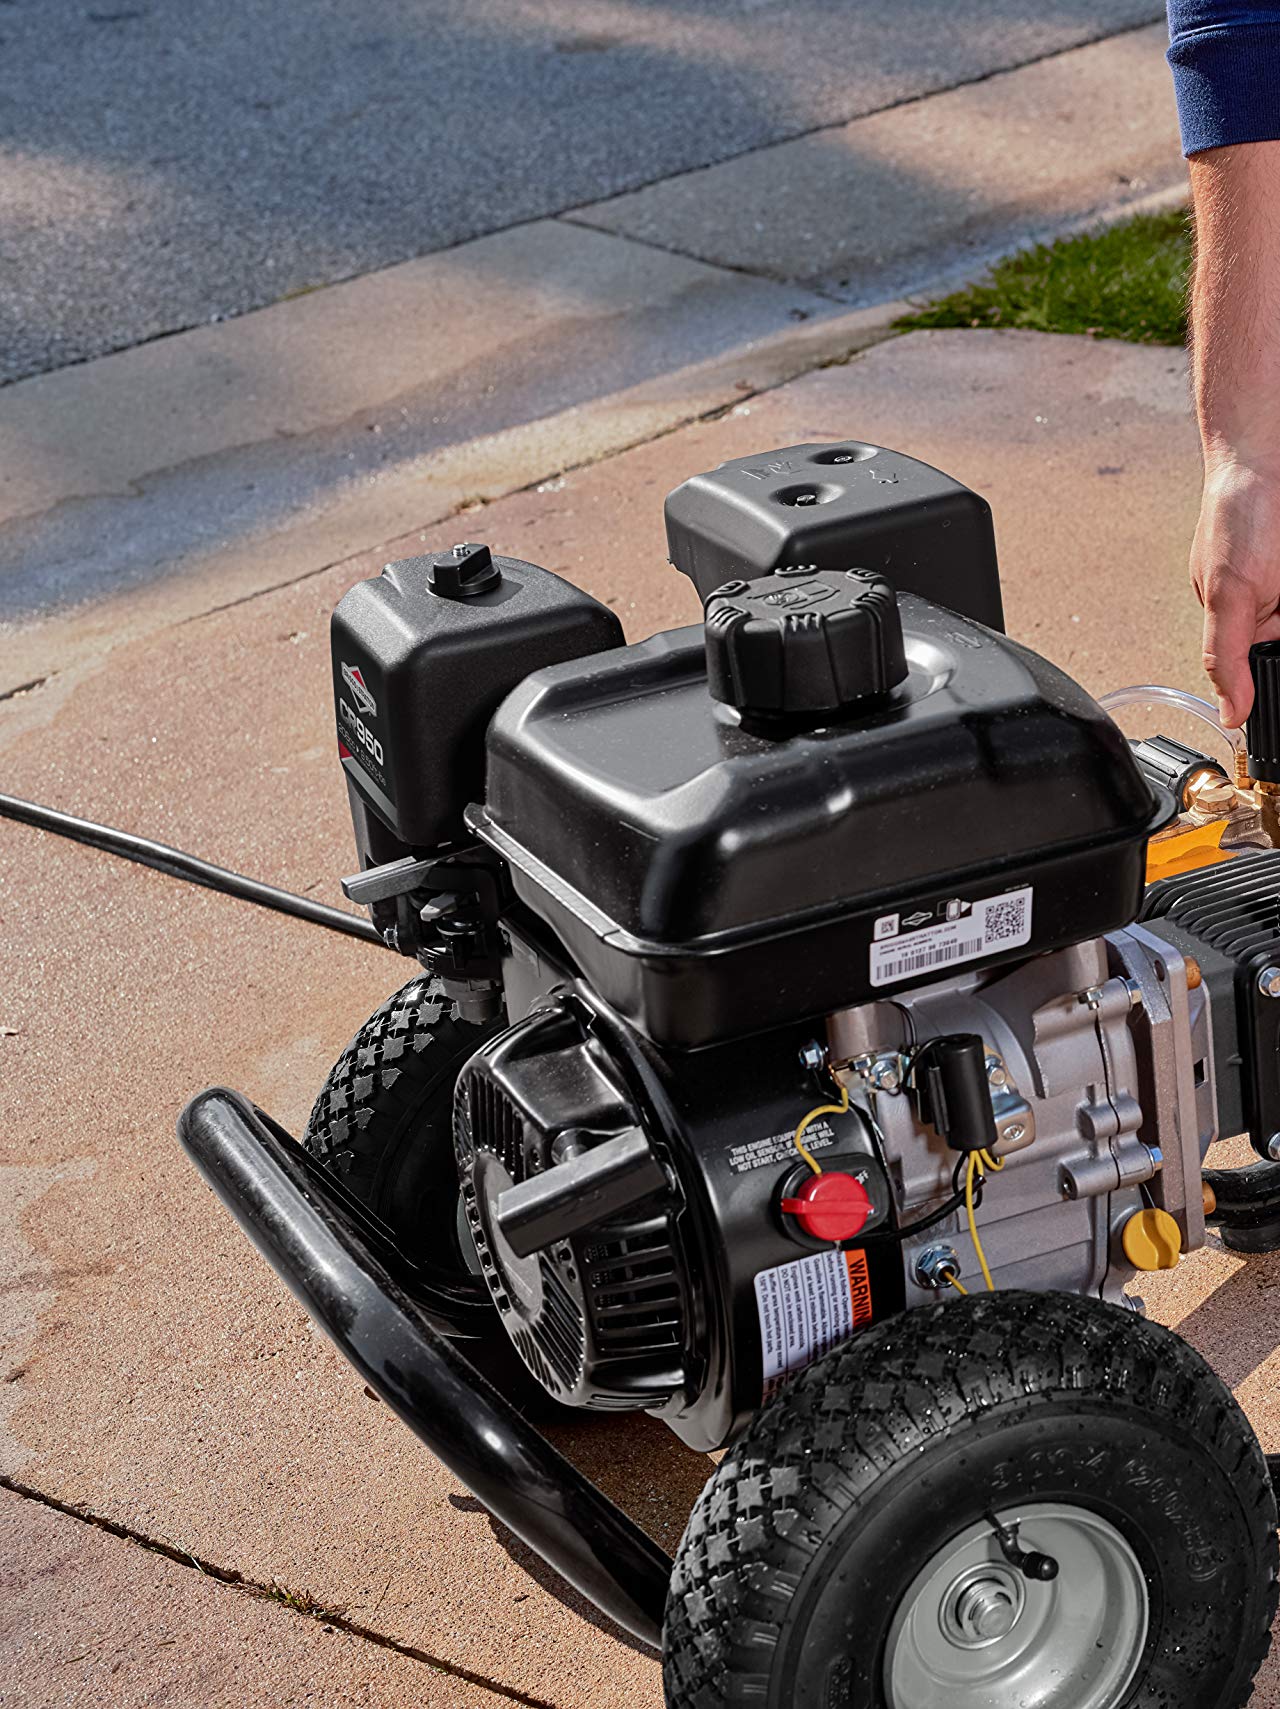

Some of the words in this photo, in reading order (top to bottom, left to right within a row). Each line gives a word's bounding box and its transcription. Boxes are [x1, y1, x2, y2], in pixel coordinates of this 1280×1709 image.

[339, 697, 384, 766] CR950
[729, 1155, 745, 1166] LOW
[745, 1151, 757, 1161] OIL
[817, 1128, 834, 1138] WILL
[731, 1145, 748, 1156] THIS
[747, 1137, 773, 1151] ENGINE
[805, 1122, 823, 1134] WITH
[823, 1121, 830, 1129] A
[737, 1161, 752, 1171] NOT
[849, 1257, 872, 1328] WARNIN
